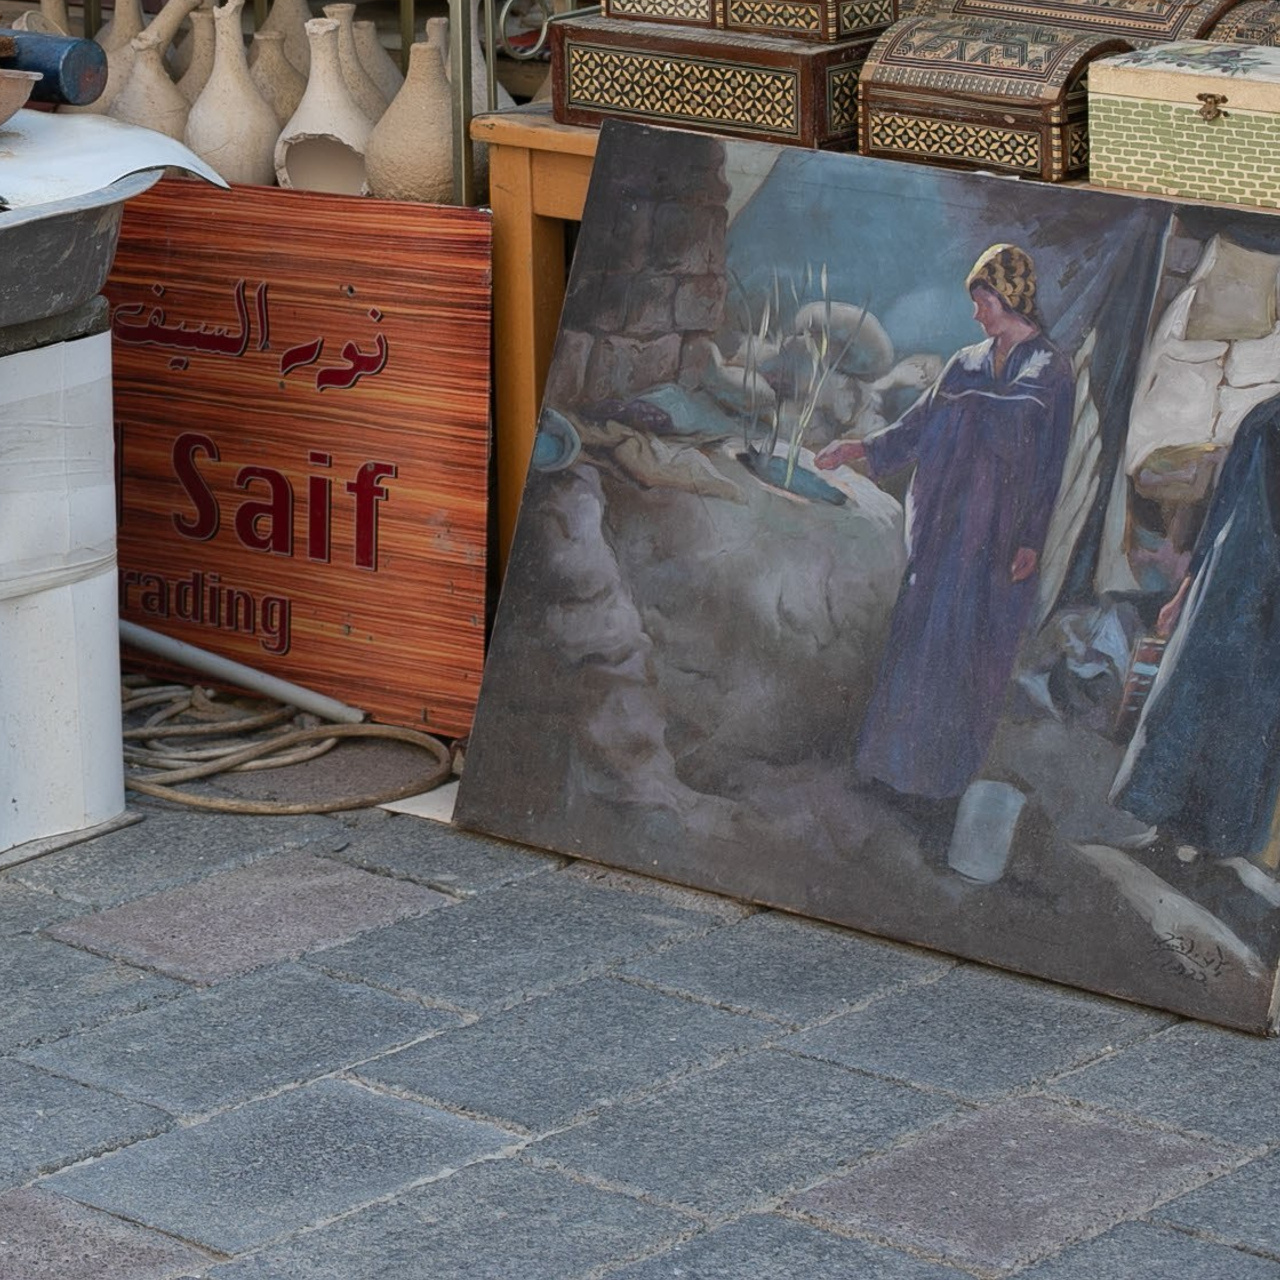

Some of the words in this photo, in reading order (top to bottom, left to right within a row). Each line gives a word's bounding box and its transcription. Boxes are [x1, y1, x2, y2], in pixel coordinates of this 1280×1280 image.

[112, 278, 268, 371] السيف
[280, 306, 387, 391] نور
[172, 431, 398, 571] Saif
[119, 570, 291, 656] rading
